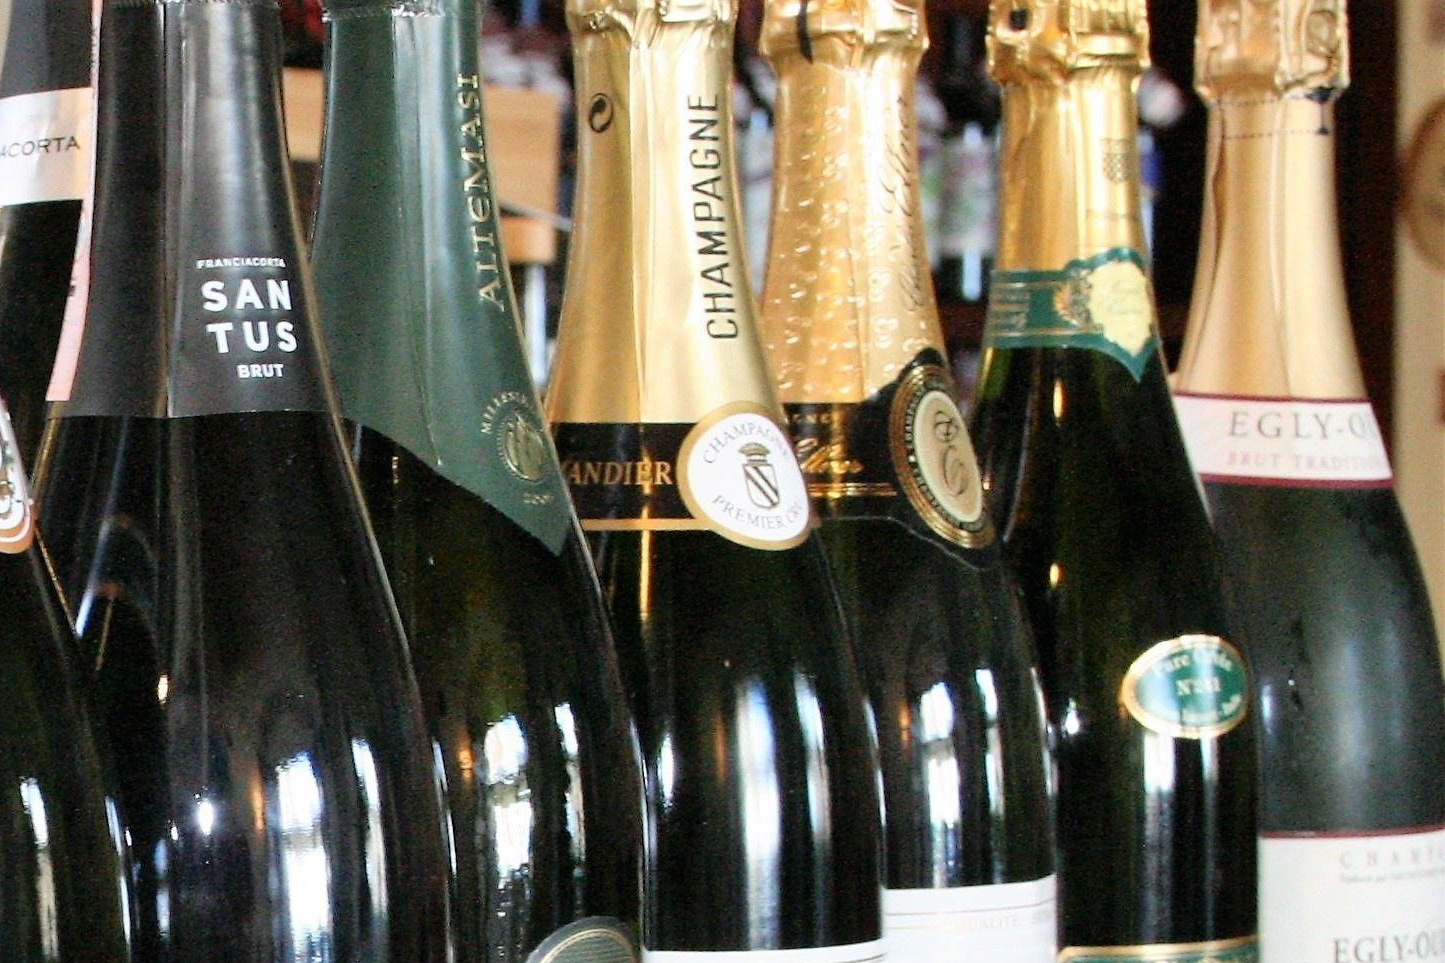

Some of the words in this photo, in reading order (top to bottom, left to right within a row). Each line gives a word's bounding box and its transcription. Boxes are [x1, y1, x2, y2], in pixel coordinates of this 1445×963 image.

[687, 94, 739, 340] CHAMPAGNE
[197, 256, 286, 270] FRANCIACORTA
[201, 279, 292, 312] SAN
[206, 320, 297, 354] TUS
[237, 363, 284, 378] BRUT
